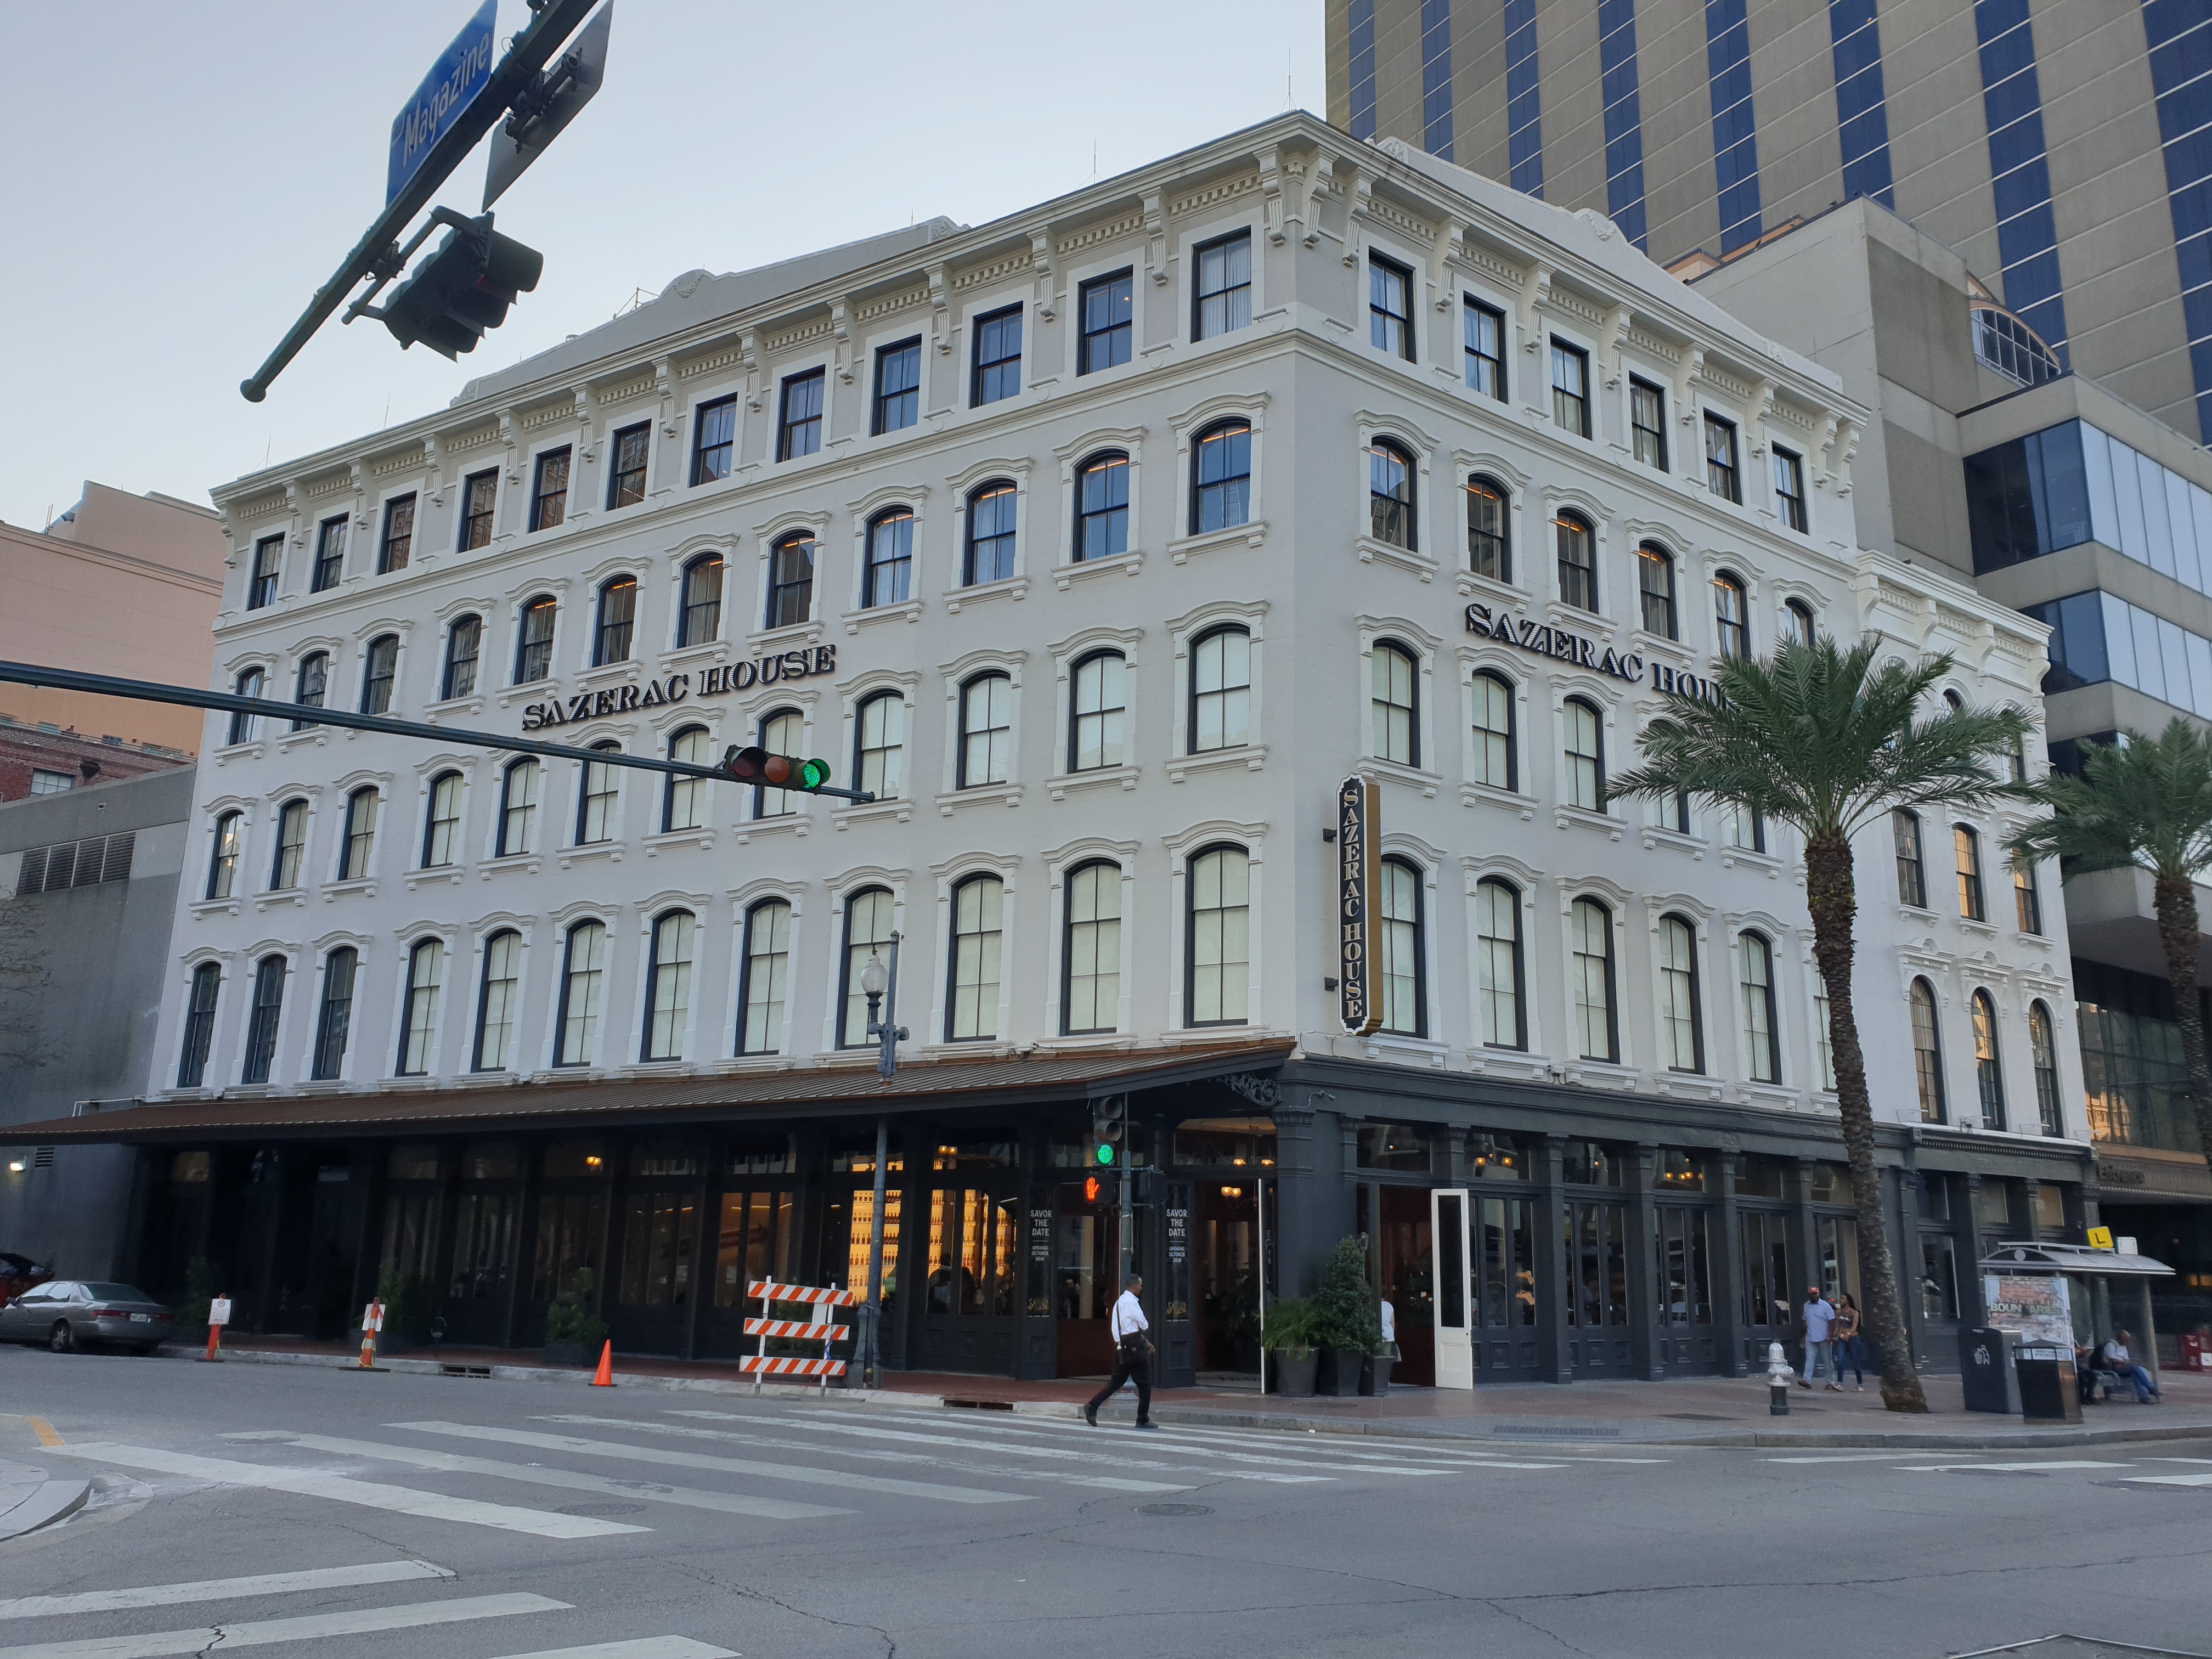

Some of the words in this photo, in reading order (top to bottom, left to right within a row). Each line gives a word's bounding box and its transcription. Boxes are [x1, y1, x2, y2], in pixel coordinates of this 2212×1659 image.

[403, 32, 489, 168] Magazine
[522, 674, 689, 731] SAZERAC
[697, 644, 836, 697] HOUSE
[1465, 603, 1644, 684] SAZERAC
[1651, 662, 1743, 715] HOU
[1343, 788, 1361, 918] SAZERAC
[1342, 922, 1363, 1019] HOUSE
[1166, 1209, 1188, 1217] SAVOR
[1170, 1218, 1183, 1227] THE
[2095, 1232, 2106, 1244] L
[1991, 1303, 2062, 1314] BOUNARIES
